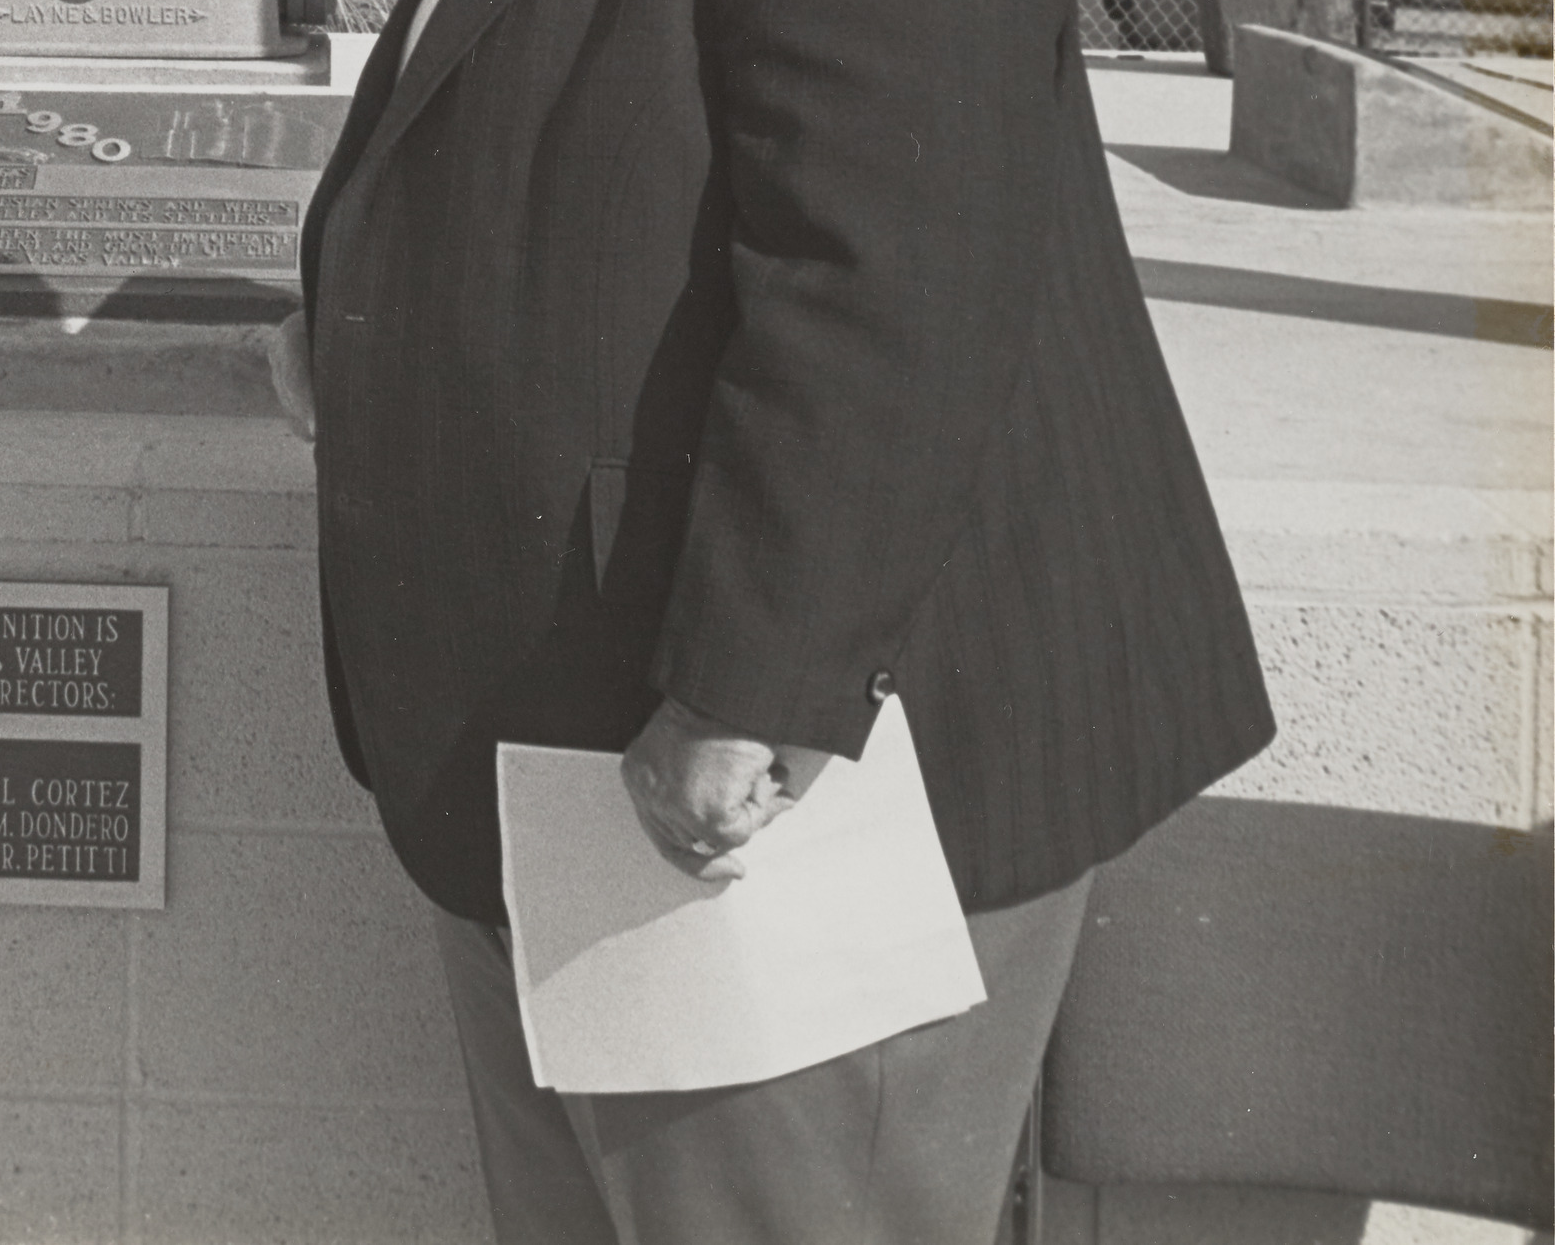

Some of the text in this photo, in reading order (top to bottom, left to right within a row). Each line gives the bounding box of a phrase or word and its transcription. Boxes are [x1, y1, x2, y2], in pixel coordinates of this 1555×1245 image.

[68, 199, 152, 211] SPRINGS
[164, 201, 204, 212] AND
[223, 202, 291, 214] WELLS
[68, 210, 107, 222] AND
[120, 211, 153, 222] ITS
[54, 230, 92, 241] THE
[102, 231, 160, 243] MOST
[172, 232, 294, 246] IMPORTANT
[51, 241, 92, 253] AND
[102, 243, 193, 255] GROWTH
[25, 253, 87, 266] VEGAS
[97, 615, 118, 642] IS
[15, 646, 102, 676] VALLEY
[31, 779, 130, 808] CORTEZ
